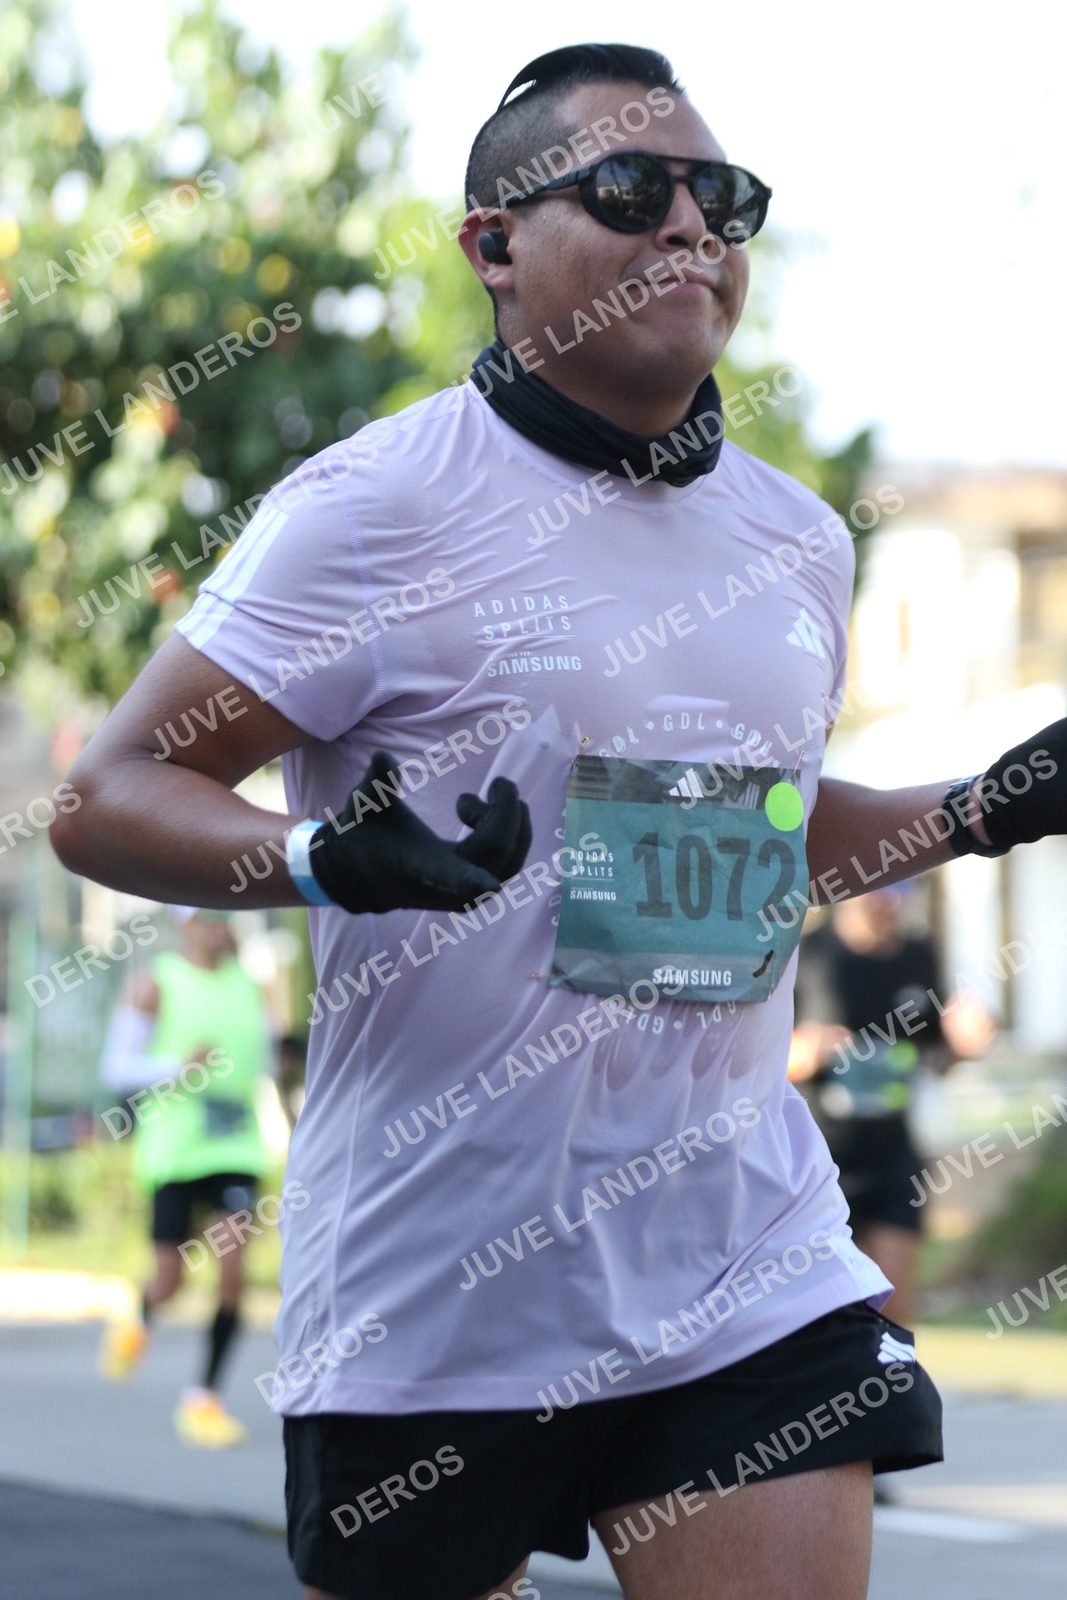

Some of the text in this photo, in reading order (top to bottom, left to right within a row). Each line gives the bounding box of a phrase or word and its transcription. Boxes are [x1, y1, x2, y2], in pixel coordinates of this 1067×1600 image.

[474, 595, 569, 617] ADIDAS
[483, 616, 571, 640] SPLITS
[487, 656, 582, 677] SAMSUNG
[661, 712, 705, 732] GDL
[570, 851, 614, 862] ADIDAS
[572, 865, 613, 877] SPLITS
[632, 832, 800, 922] 1072
[570, 890, 617, 901] SAMSUNG
[652, 968, 732, 986] SAMSUNG
